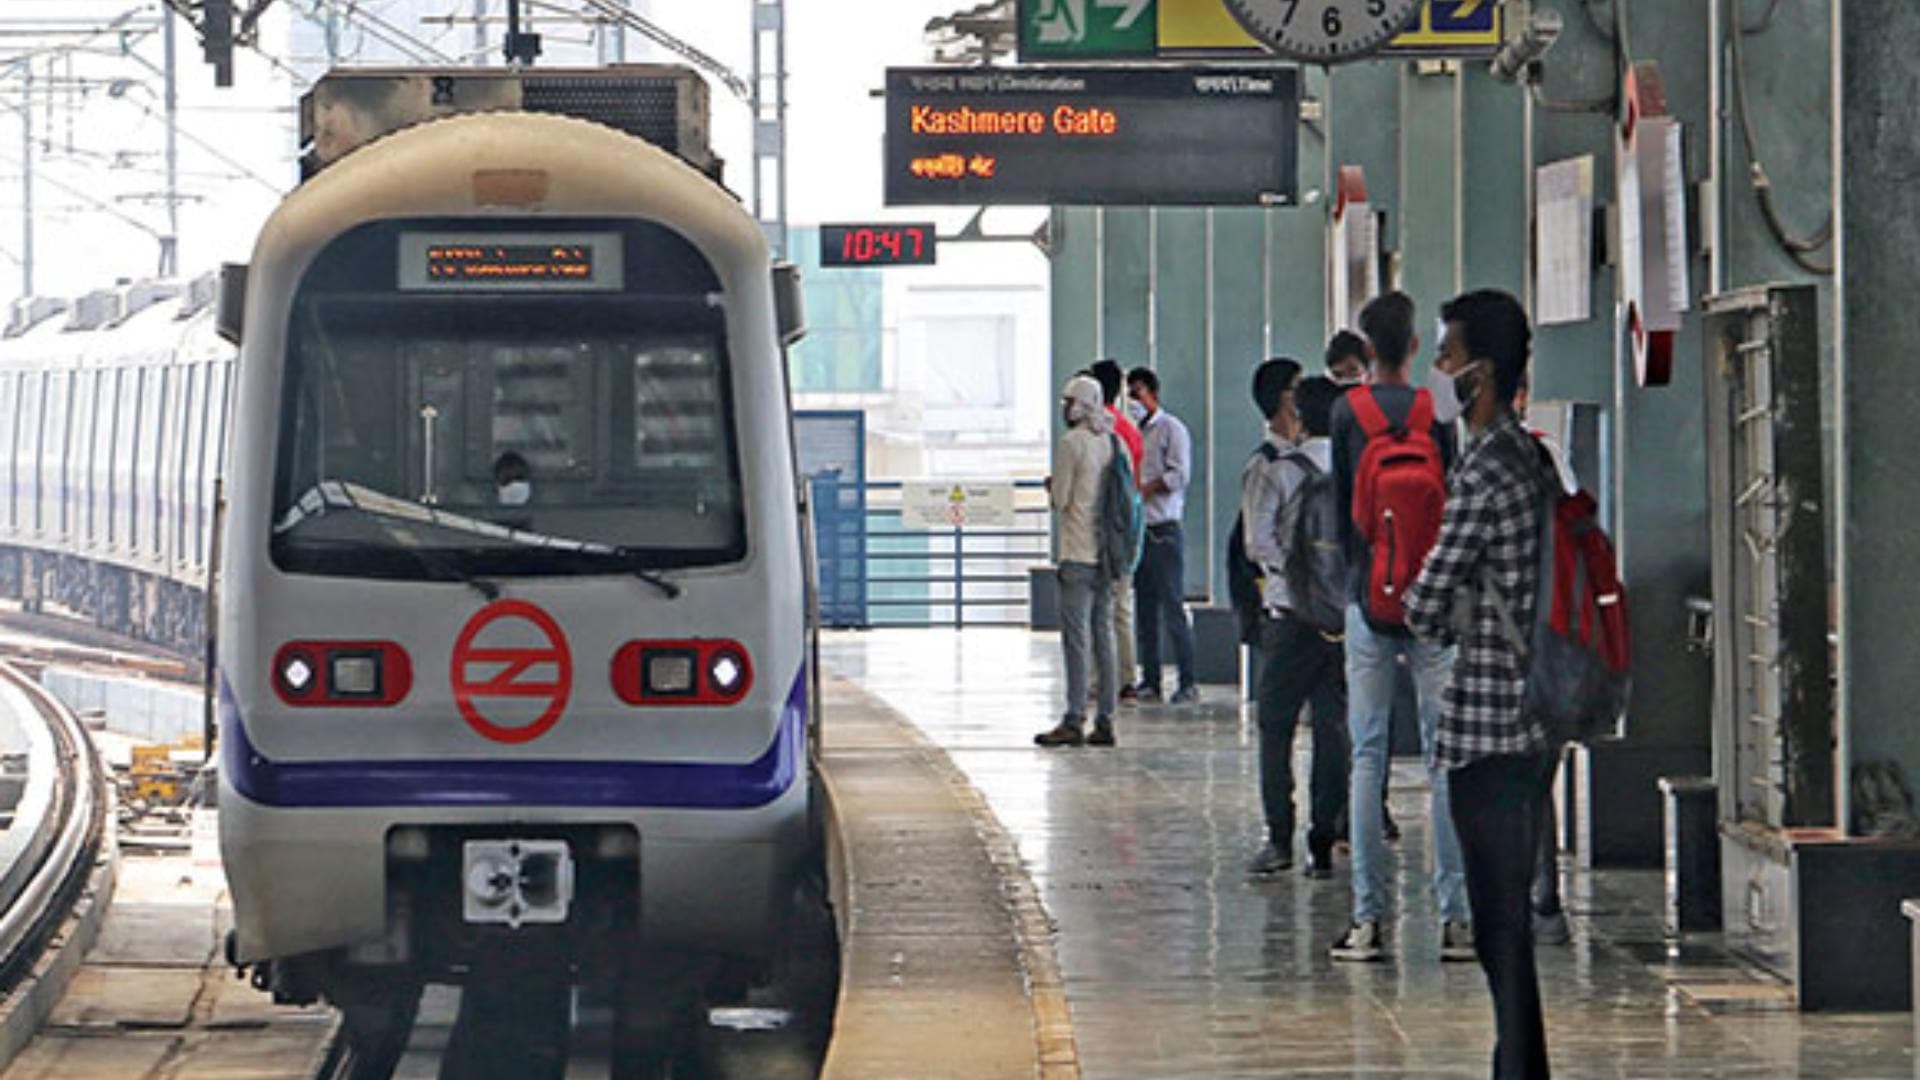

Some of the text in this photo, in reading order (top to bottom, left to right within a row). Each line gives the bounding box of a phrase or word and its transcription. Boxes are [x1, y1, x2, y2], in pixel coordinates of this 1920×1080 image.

[1280, 0, 1298, 26] 7
[1322, 6, 1342, 37] 6
[911, 104, 1117, 134] Kashmere Gate
[843, 228, 924, 262] 10:47
